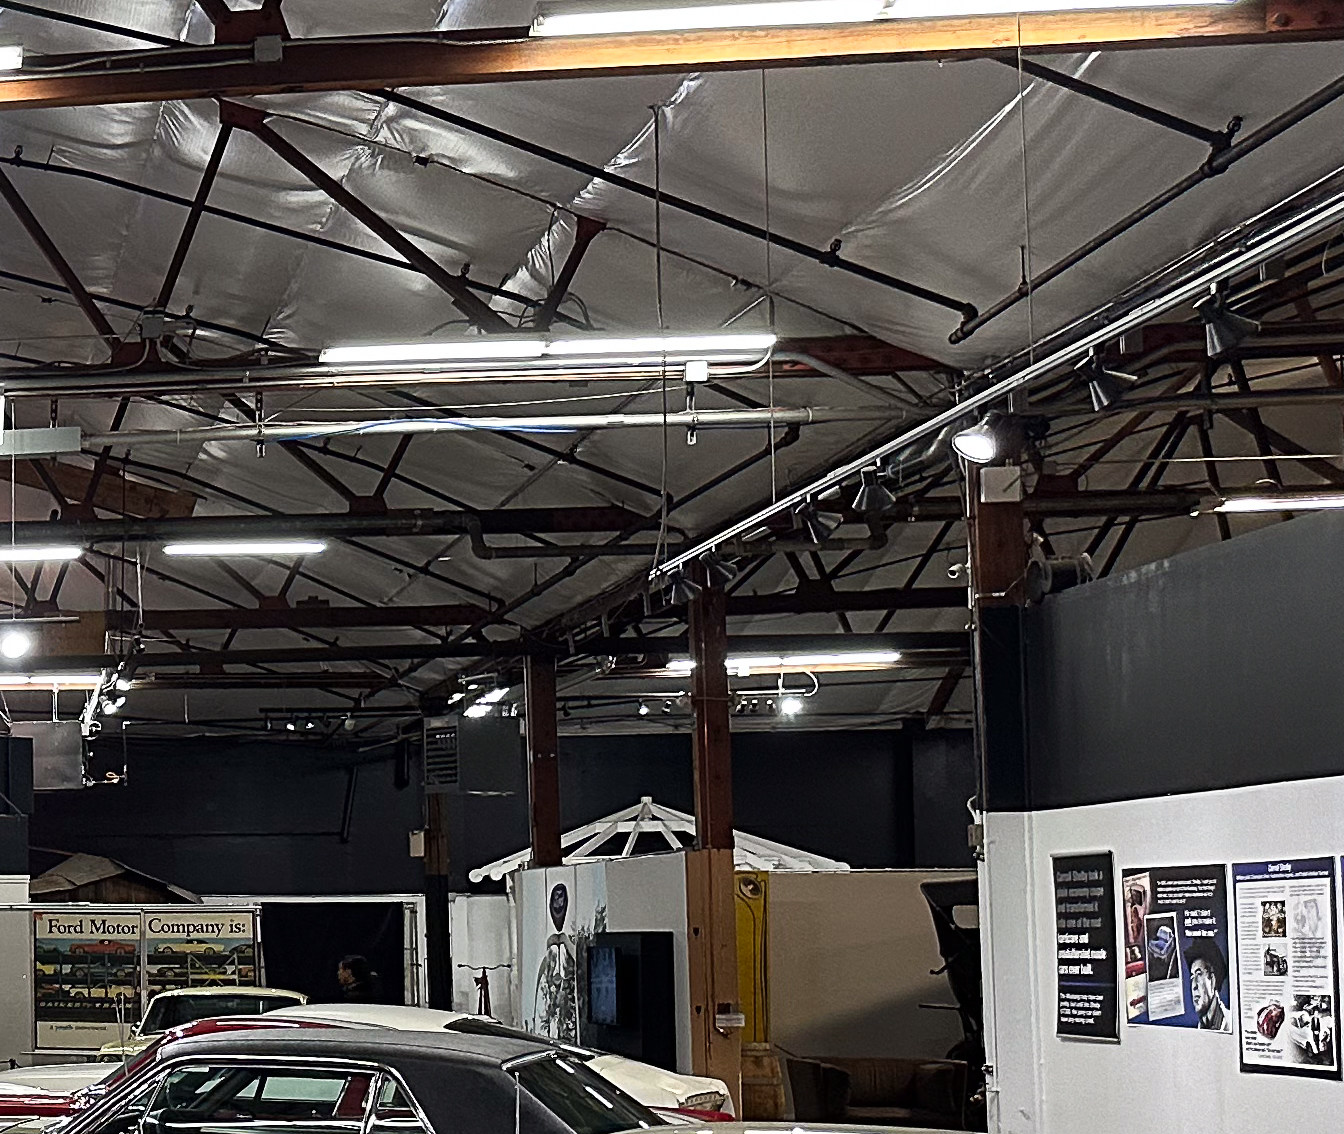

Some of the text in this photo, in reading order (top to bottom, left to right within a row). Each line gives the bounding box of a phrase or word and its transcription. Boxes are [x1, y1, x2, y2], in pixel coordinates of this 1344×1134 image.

[48, 917, 246, 938] Ford Motor Company is:
